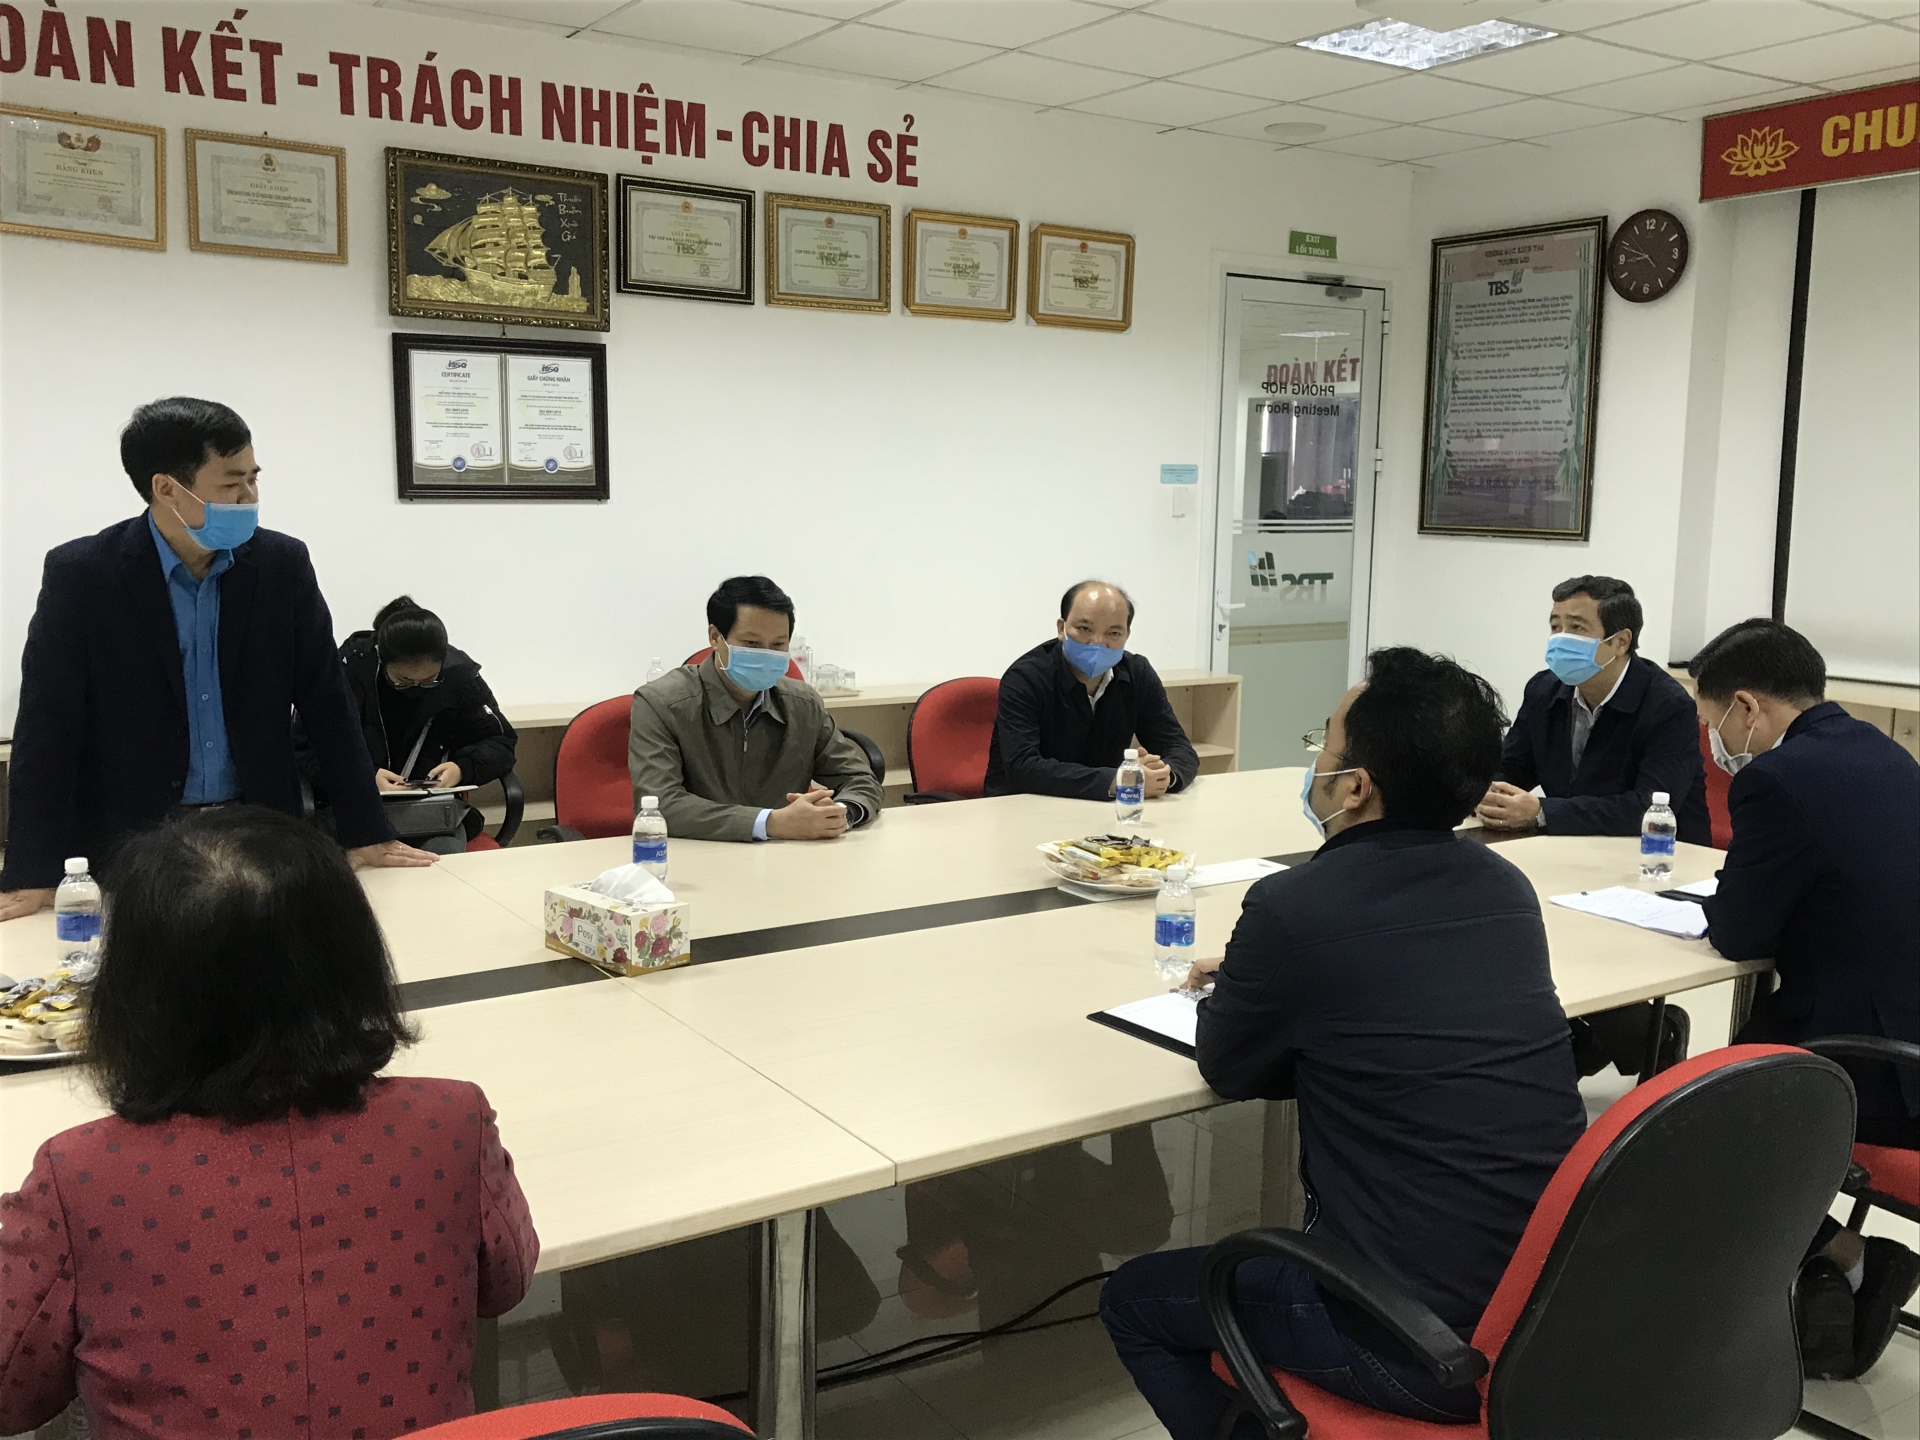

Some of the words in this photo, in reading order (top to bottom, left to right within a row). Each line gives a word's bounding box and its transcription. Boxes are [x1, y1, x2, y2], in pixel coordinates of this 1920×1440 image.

[161, 8, 284, 106] KẾT
[328, 50, 523, 137] TRÁCH
[541, 82, 707, 166] NHIỆM
[741, 110, 851, 179] CHIA
[866, 113, 919, 188] SẺ
[1821, 102, 1920, 158] CHU
[1645, 218, 1657, 230] 12
[1305, 234, 1321, 243] EXIT
[1619, 254, 1626, 265] 9
[1671, 247, 1679, 260] 3
[1487, 280, 1510, 296] TBS
[1642, 283, 1650, 294] 6
[1323, 347, 1360, 384] KẾT
[441, 371, 471, 379] CERTIFICATE
[577, 924, 594, 942] Posy
